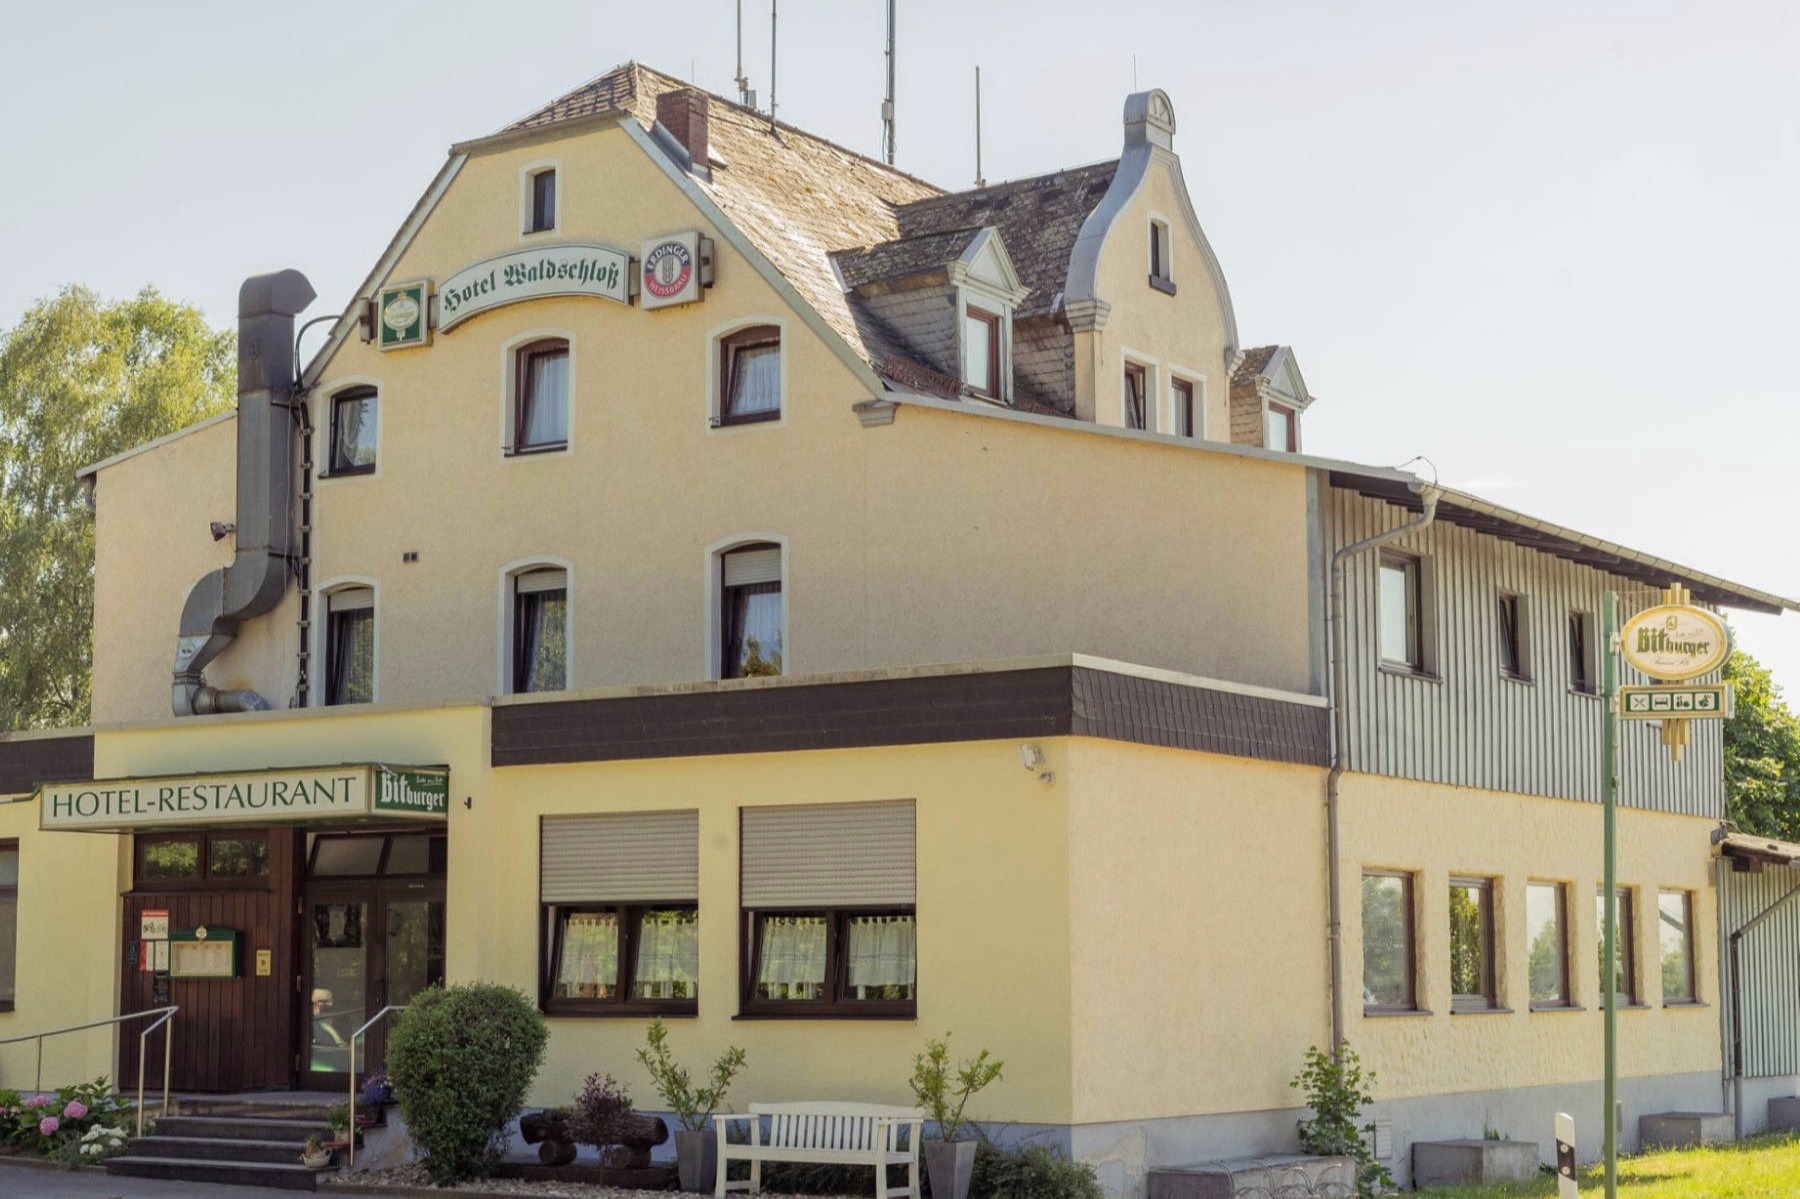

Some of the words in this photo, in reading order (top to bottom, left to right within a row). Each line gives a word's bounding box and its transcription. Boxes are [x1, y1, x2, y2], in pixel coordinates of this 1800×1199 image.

[444, 271, 496, 311] Hotel
[504, 259, 619, 290] Waldschloß
[1637, 626, 1709, 659] Bitburger
[53, 777, 356, 817] HOTEL-RESTAURANT
